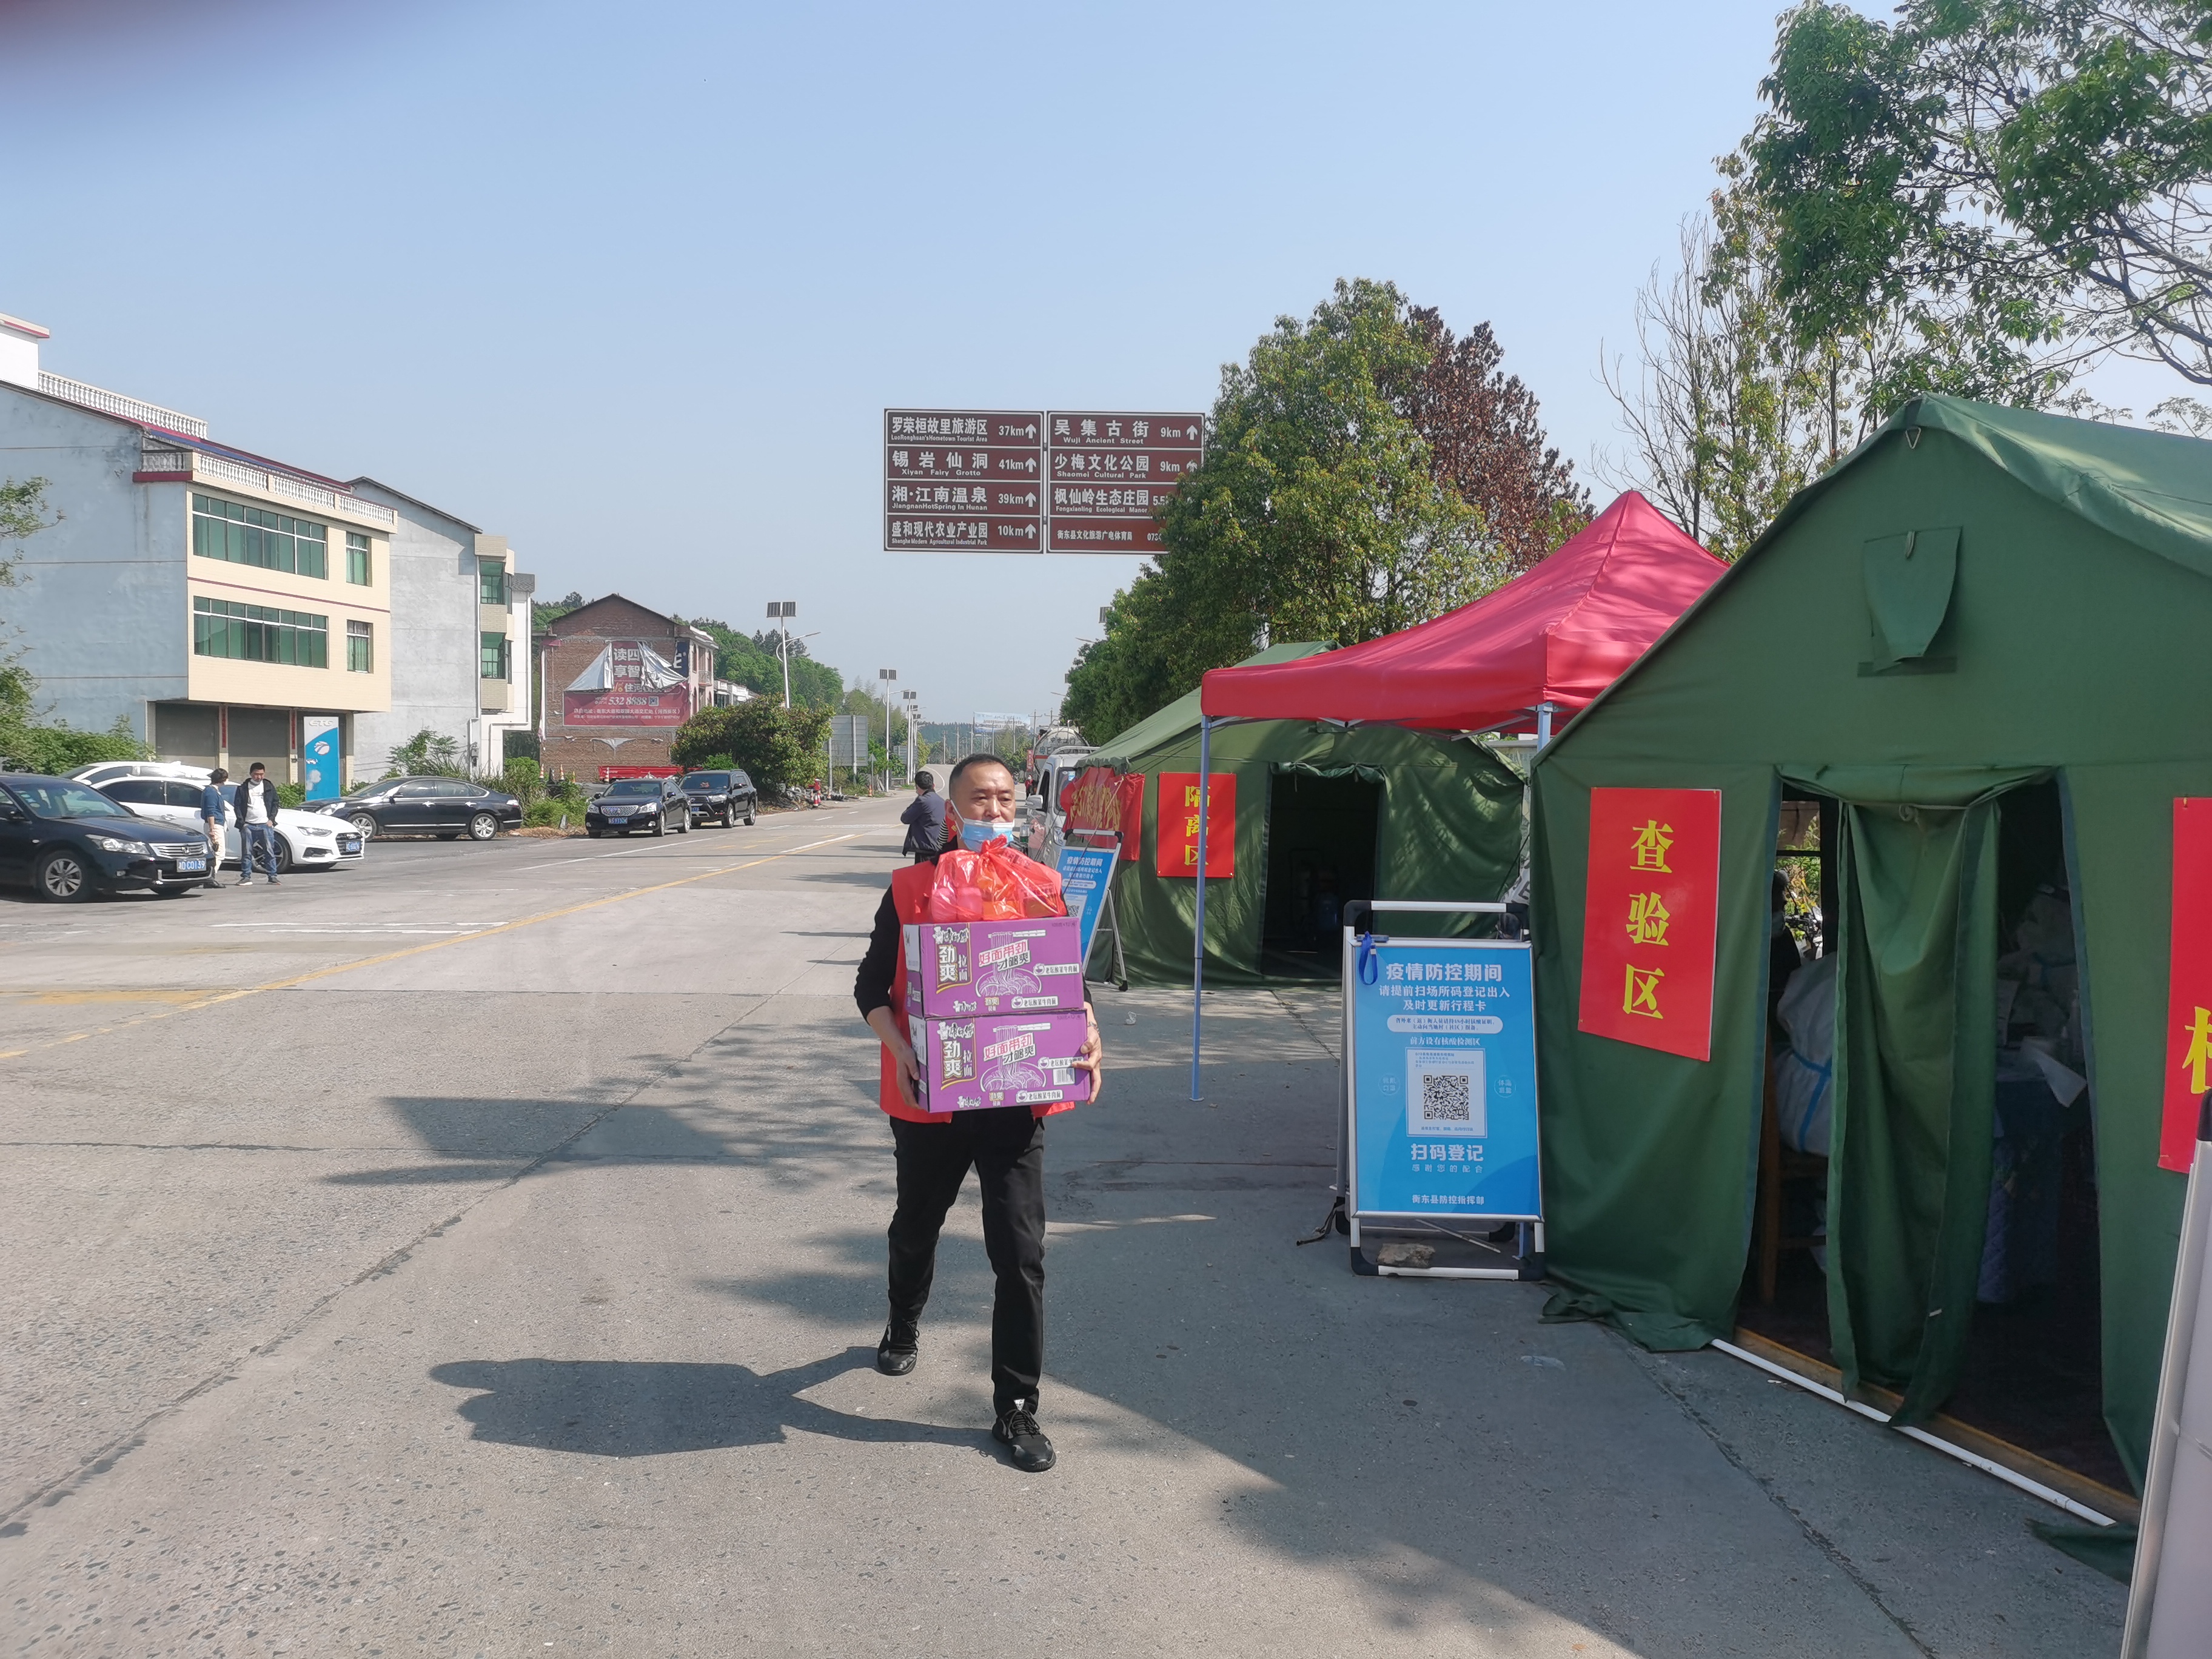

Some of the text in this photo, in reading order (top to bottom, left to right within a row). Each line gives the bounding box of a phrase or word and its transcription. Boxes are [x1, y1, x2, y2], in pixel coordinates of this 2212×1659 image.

[892, 417, 1024, 436] 罗荣桓故里旅游区 37km
[1054, 419, 1181, 438] 吴集古街 9km
[892, 451, 1024, 470] 锡岩仙洞 41km
[1054, 453, 1180, 472] 少梅文化公园 9km
[892, 485, 1024, 504] 湘·江南温泉 39km
[1054, 488, 1148, 506] 枫仙岭生态庄园
[892, 521, 1024, 538] 盛和现代农业产业园 10km
[1057, 530, 1133, 540] 衡东县文化旅游广电体育局
[1184, 785, 1211, 865] 隔离区
[1623, 820, 1674, 1019] 查验区
[939, 945, 957, 982] 劲爽
[1386, 963, 1503, 982] 疫情防控期间
[1379, 985, 1510, 997] 请提前扫场所码登记出入
[1403, 999, 1487, 1012] 及时更新行程卡
[1410, 1036, 1481, 1046] 前方设有核酸检测区
[943, 1041, 962, 1078] 劲爽
[1410, 1143, 1484, 1162] 扫码登记
[1412, 1195, 1484, 1205] 衡东县防控指挥部
